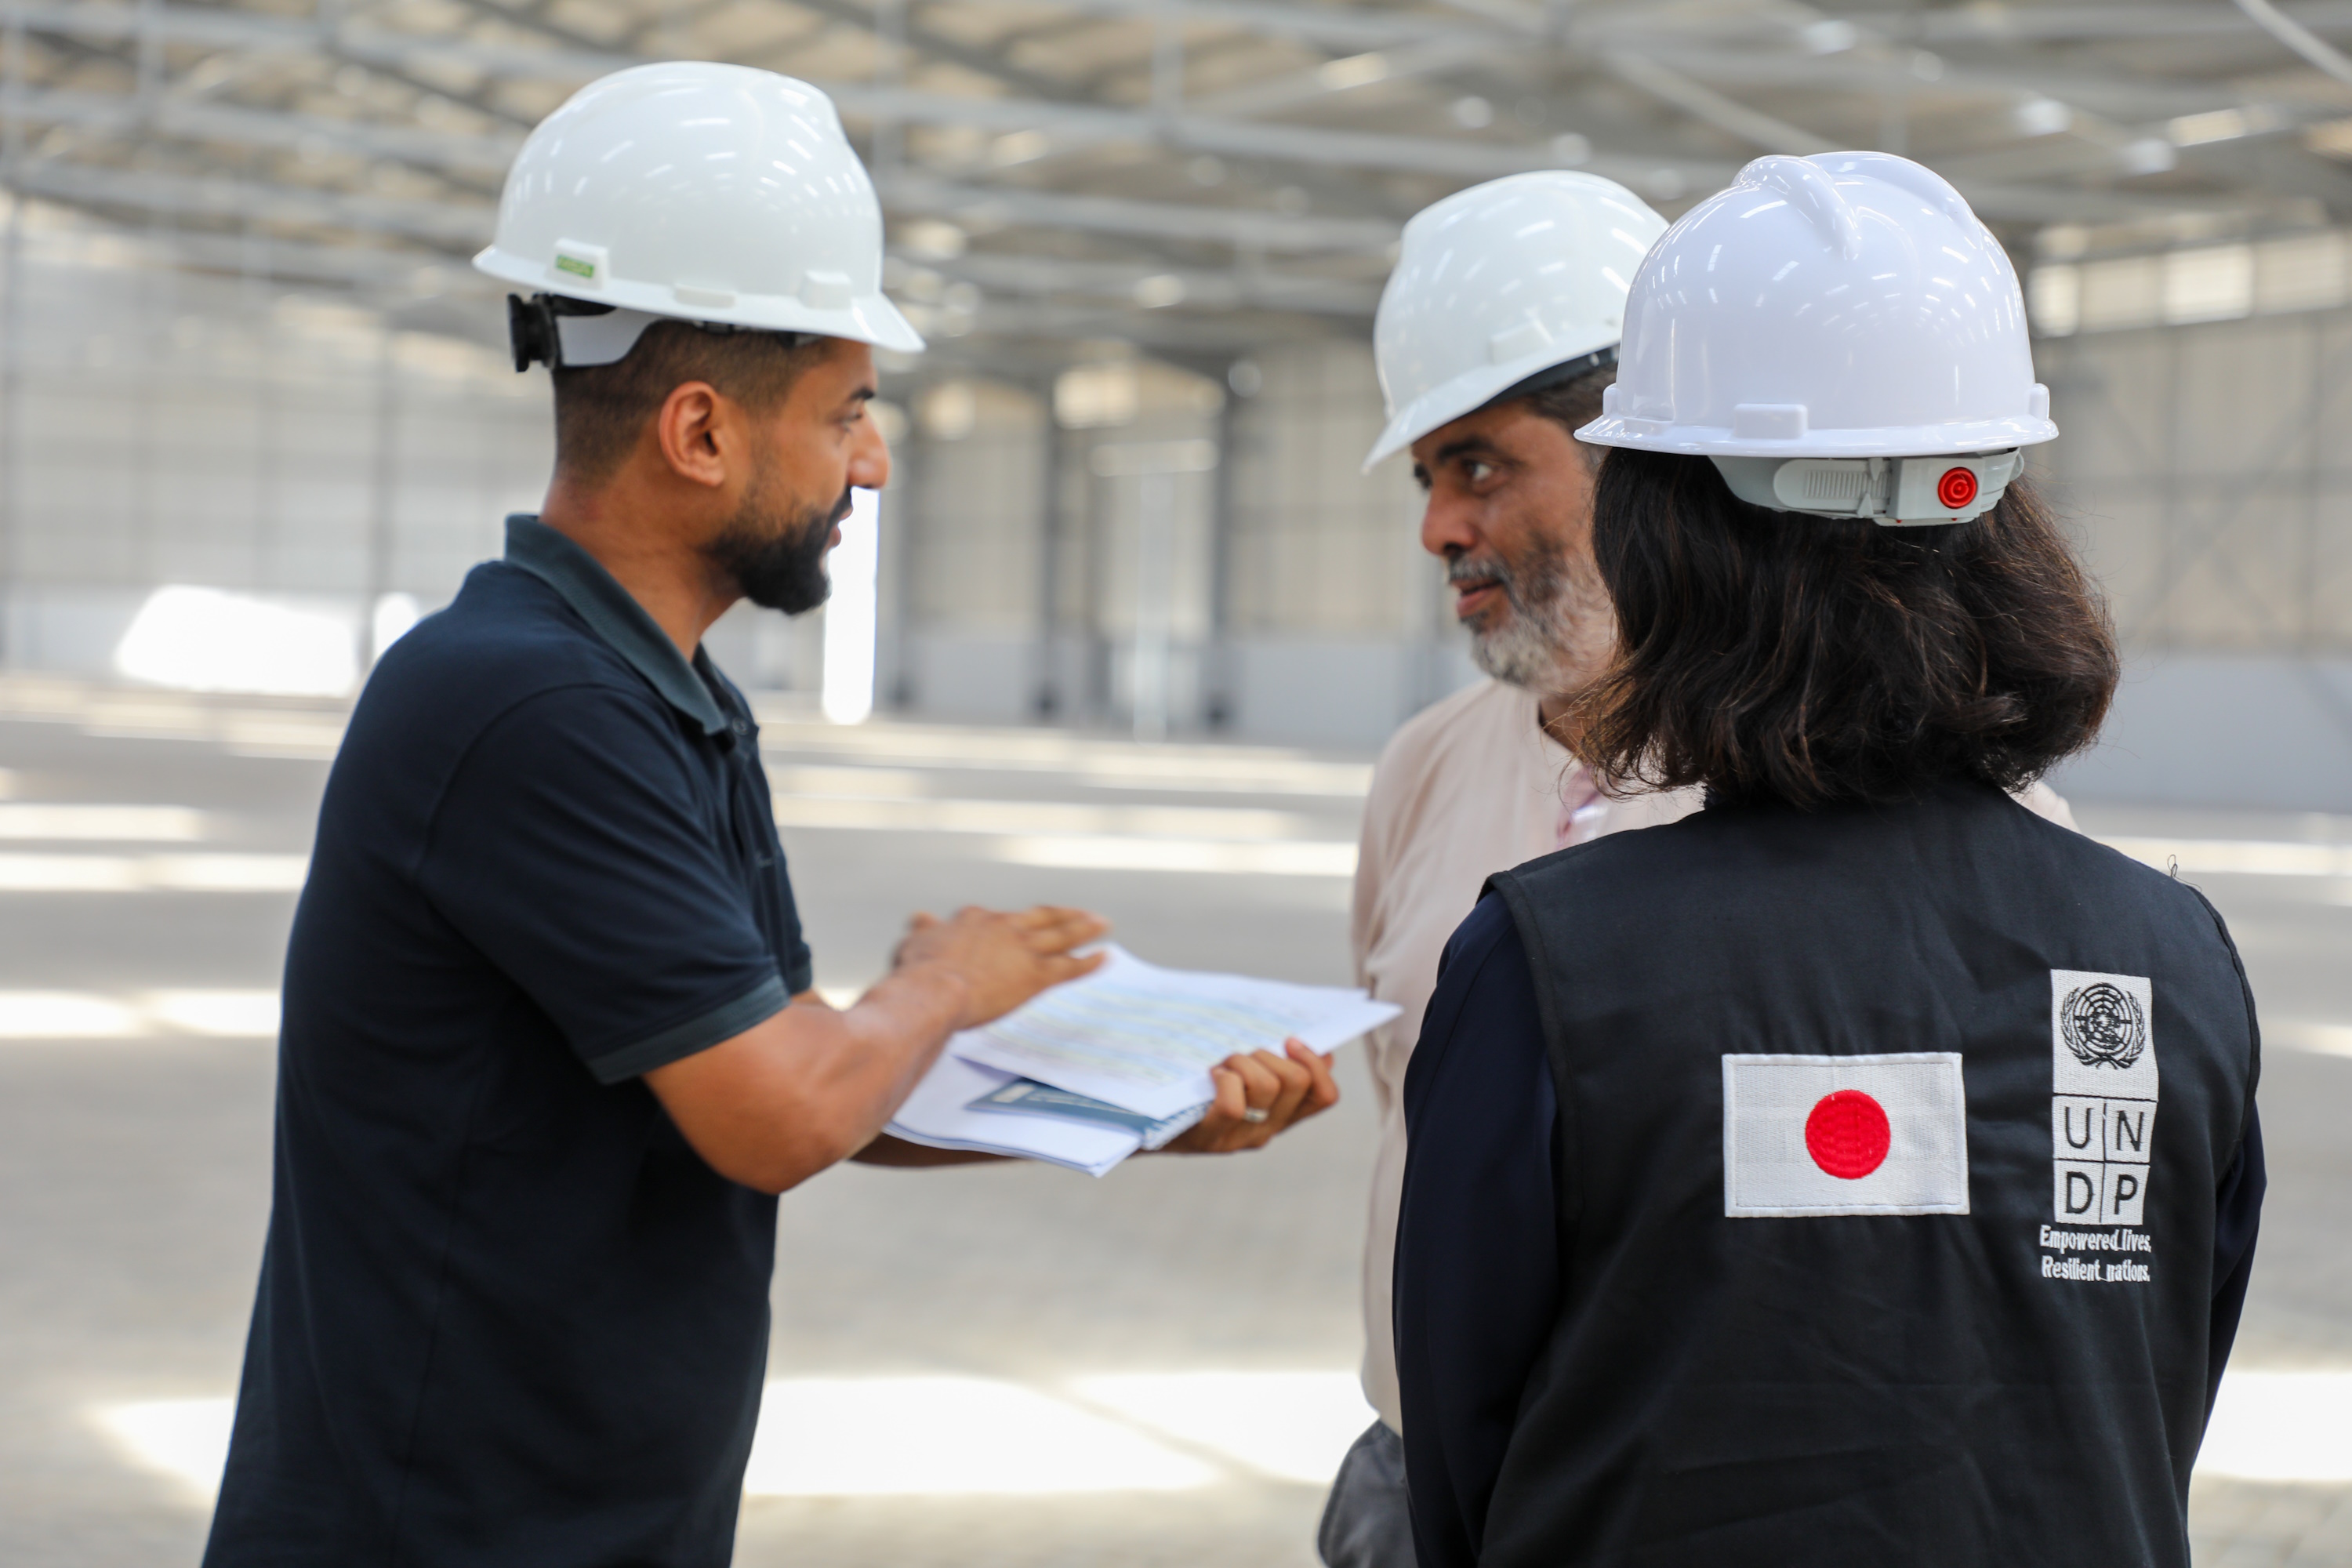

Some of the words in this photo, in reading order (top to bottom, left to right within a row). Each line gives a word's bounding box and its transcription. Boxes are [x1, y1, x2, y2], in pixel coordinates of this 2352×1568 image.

[2040, 1225, 2119, 1254] Empowered
[2122, 1229, 2151, 1252] lives.
[2042, 1255, 2100, 1281] Resilient
[2107, 1259, 2151, 1282] nations.
